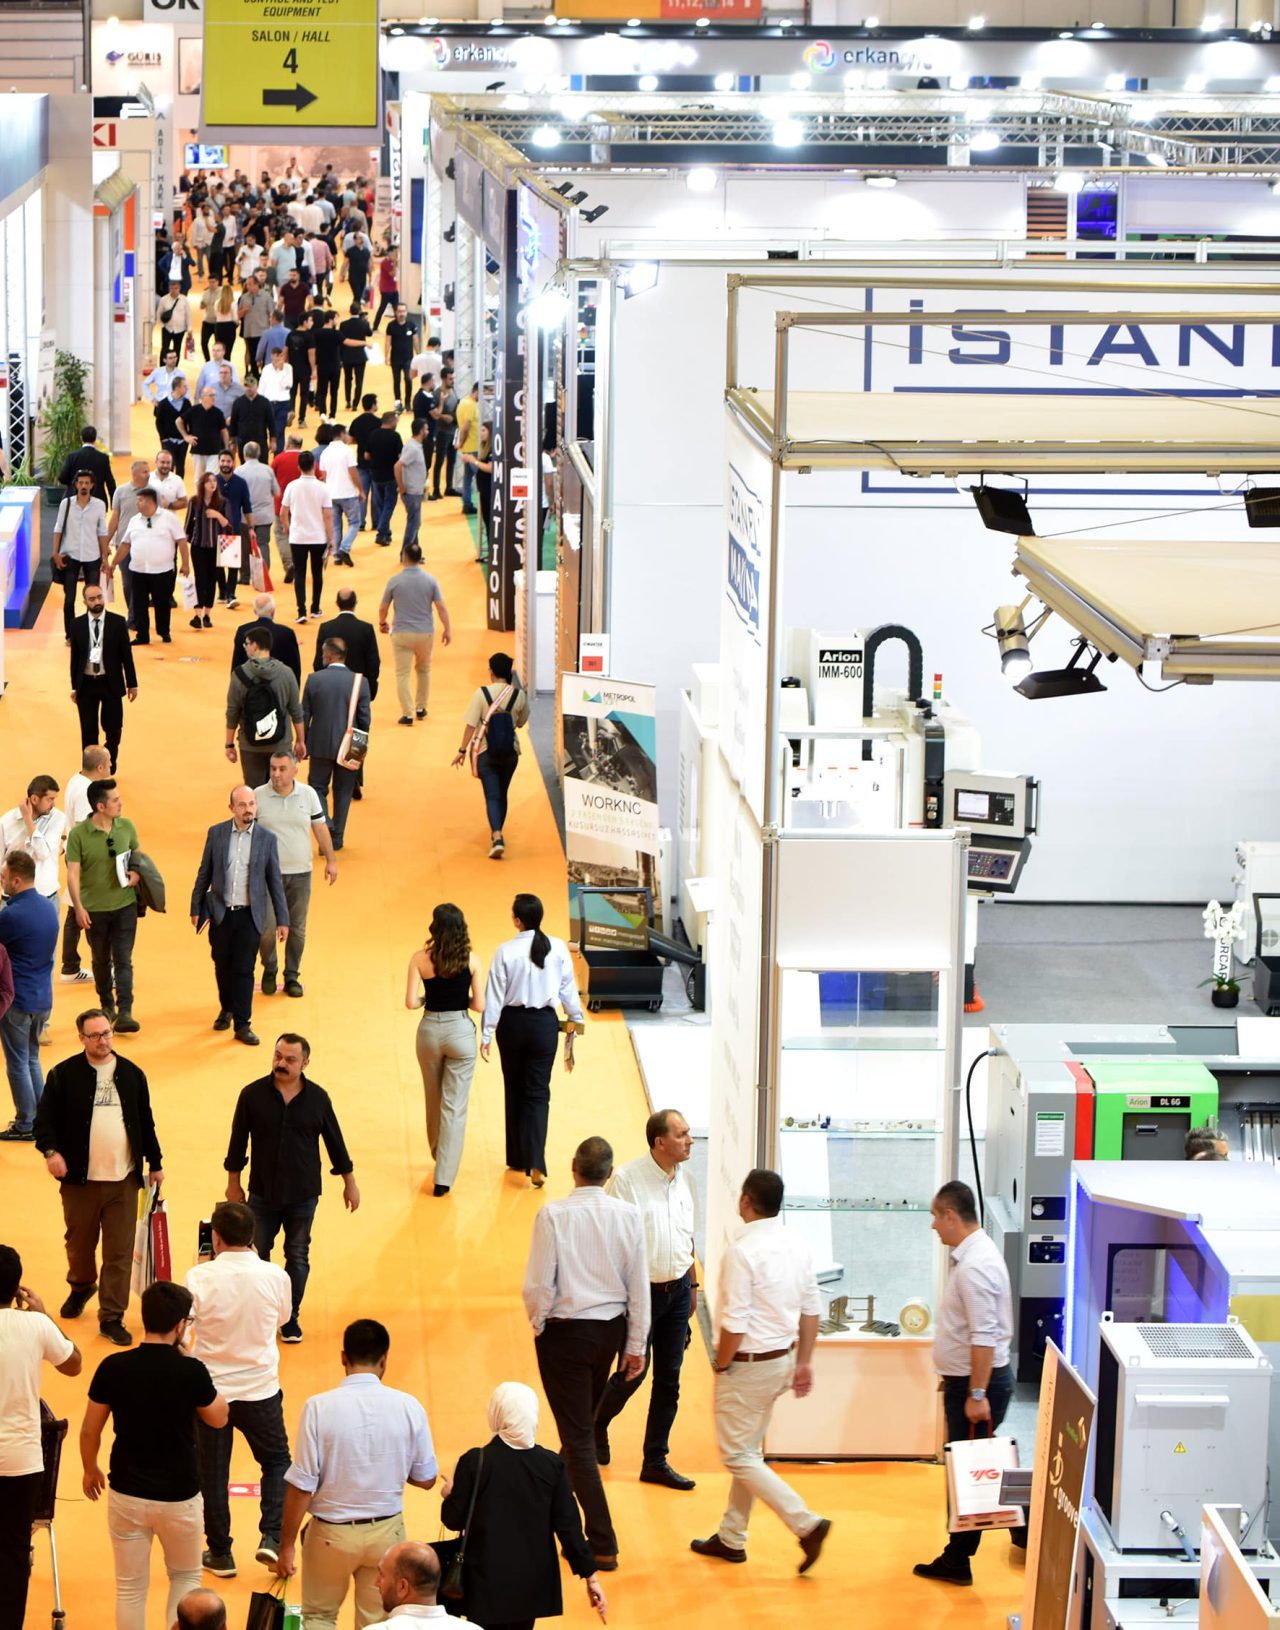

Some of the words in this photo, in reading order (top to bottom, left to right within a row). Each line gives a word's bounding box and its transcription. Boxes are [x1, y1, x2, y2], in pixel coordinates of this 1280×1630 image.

[263, 7, 321, 17] EQUIPMENT
[252, 30, 290, 42] SALON
[302, 31, 331, 42] HALL
[283, 48, 298, 73] 4
[822, 651, 860, 662] Arion
[818, 665, 863, 678] IMM-600
[581, 793, 642, 815] WORKNC
